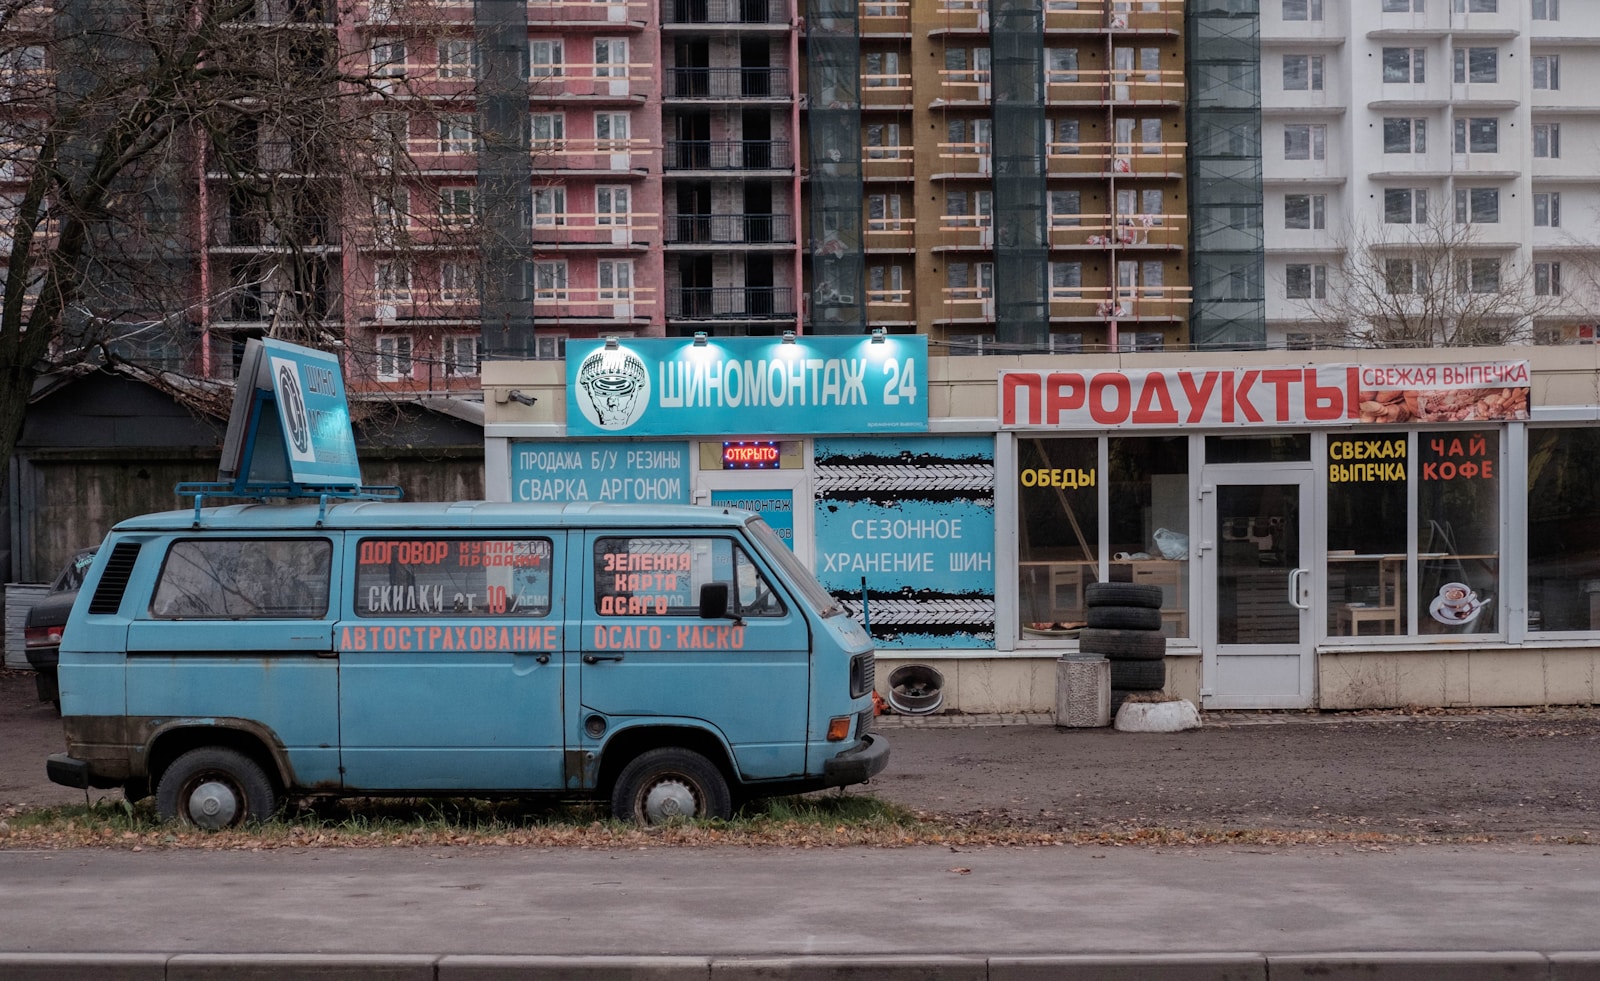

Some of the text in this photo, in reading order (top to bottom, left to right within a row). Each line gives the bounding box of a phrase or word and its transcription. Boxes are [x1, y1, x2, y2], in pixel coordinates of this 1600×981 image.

[304, 363, 336, 397] ШИНО
[659, 358, 917, 408] ШИНОМОНТАЖ 24
[1362, 364, 1528, 386] СВЕЖАЯ ВЫПЕЧКА
[1003, 367, 1360, 425] ПРОДУКТЫ
[726, 448, 776, 460] ОТКРЫТО
[1329, 439, 1406, 460] СВЕЖАЯ
[1431, 433, 1486, 457] ЧАЙ
[520, 450, 681, 473] ПРОДАЖА Б/У РЕЗИНЫ
[1423, 460, 1493, 481] КОФЕ
[1020, 468, 1096, 489] ОБЕДЫ
[1329, 463, 1406, 482] ВЫПЕЧКА
[519, 478, 681, 500] СВАРКА АРГОНОМ
[851, 519, 962, 539] СЕЗОННОЕ
[360, 541, 449, 565] ДОГОВОР
[459, 555, 540, 567] ПРОДАЖИ
[603, 553, 691, 572] ЗЕЛЕНАЯ
[823, 552, 991, 572] ХРАНЕНИЕ ШИН
[615, 573, 677, 591] КАРТА
[600, 597, 667, 615] ДСАГО
[340, 626, 557, 650] АВТОСТРАХОВАНИЕ
[594, 625, 744, 649] ОСАГО КАСКО
